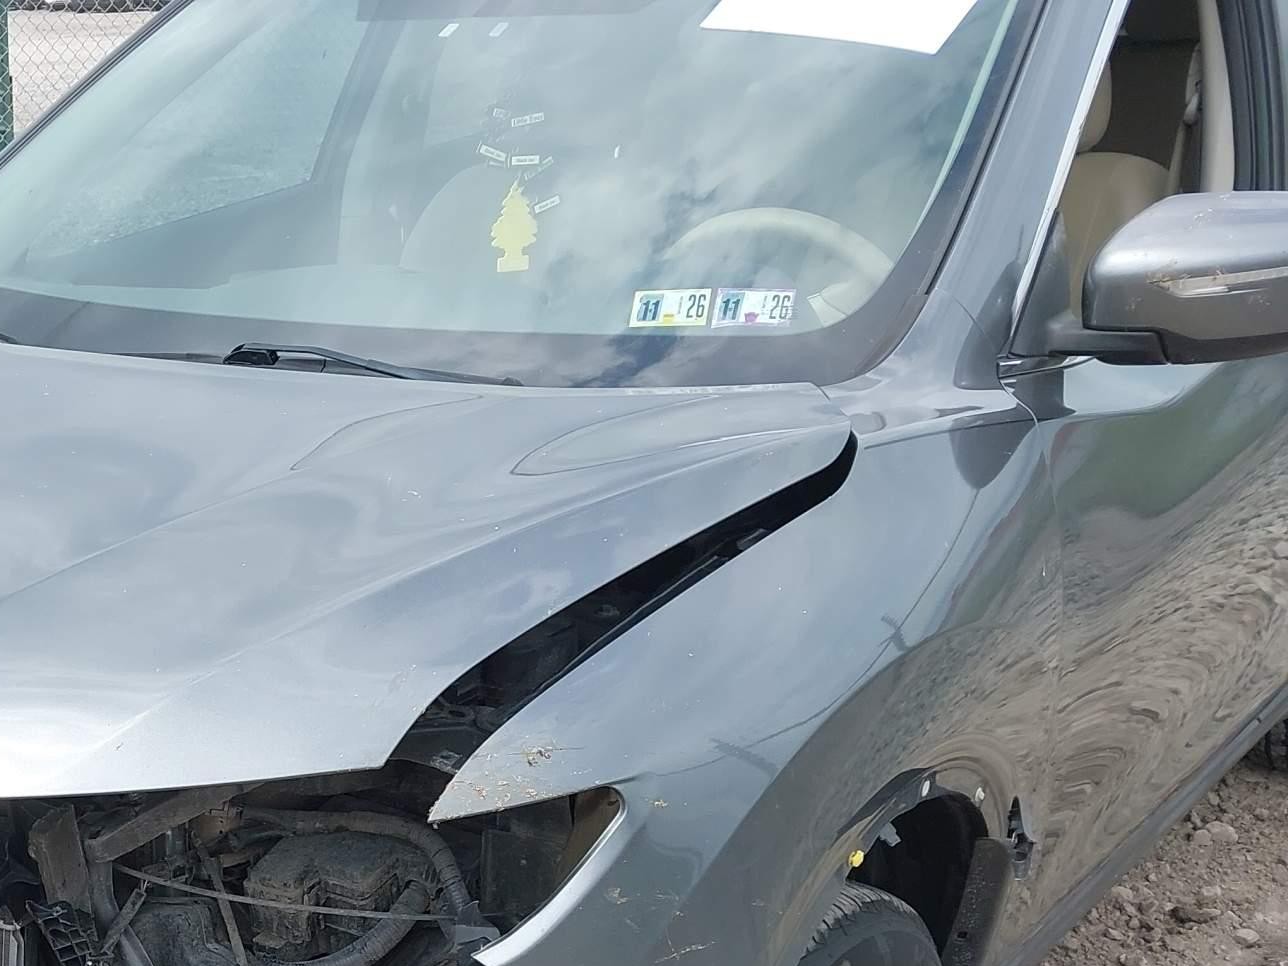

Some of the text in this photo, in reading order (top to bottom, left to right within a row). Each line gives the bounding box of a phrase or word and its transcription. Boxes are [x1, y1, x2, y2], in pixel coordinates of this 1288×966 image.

[642, 299, 661, 321] 11
[686, 294, 707, 318] 26
[721, 298, 741, 320] 11
[769, 294, 791, 320] 26
